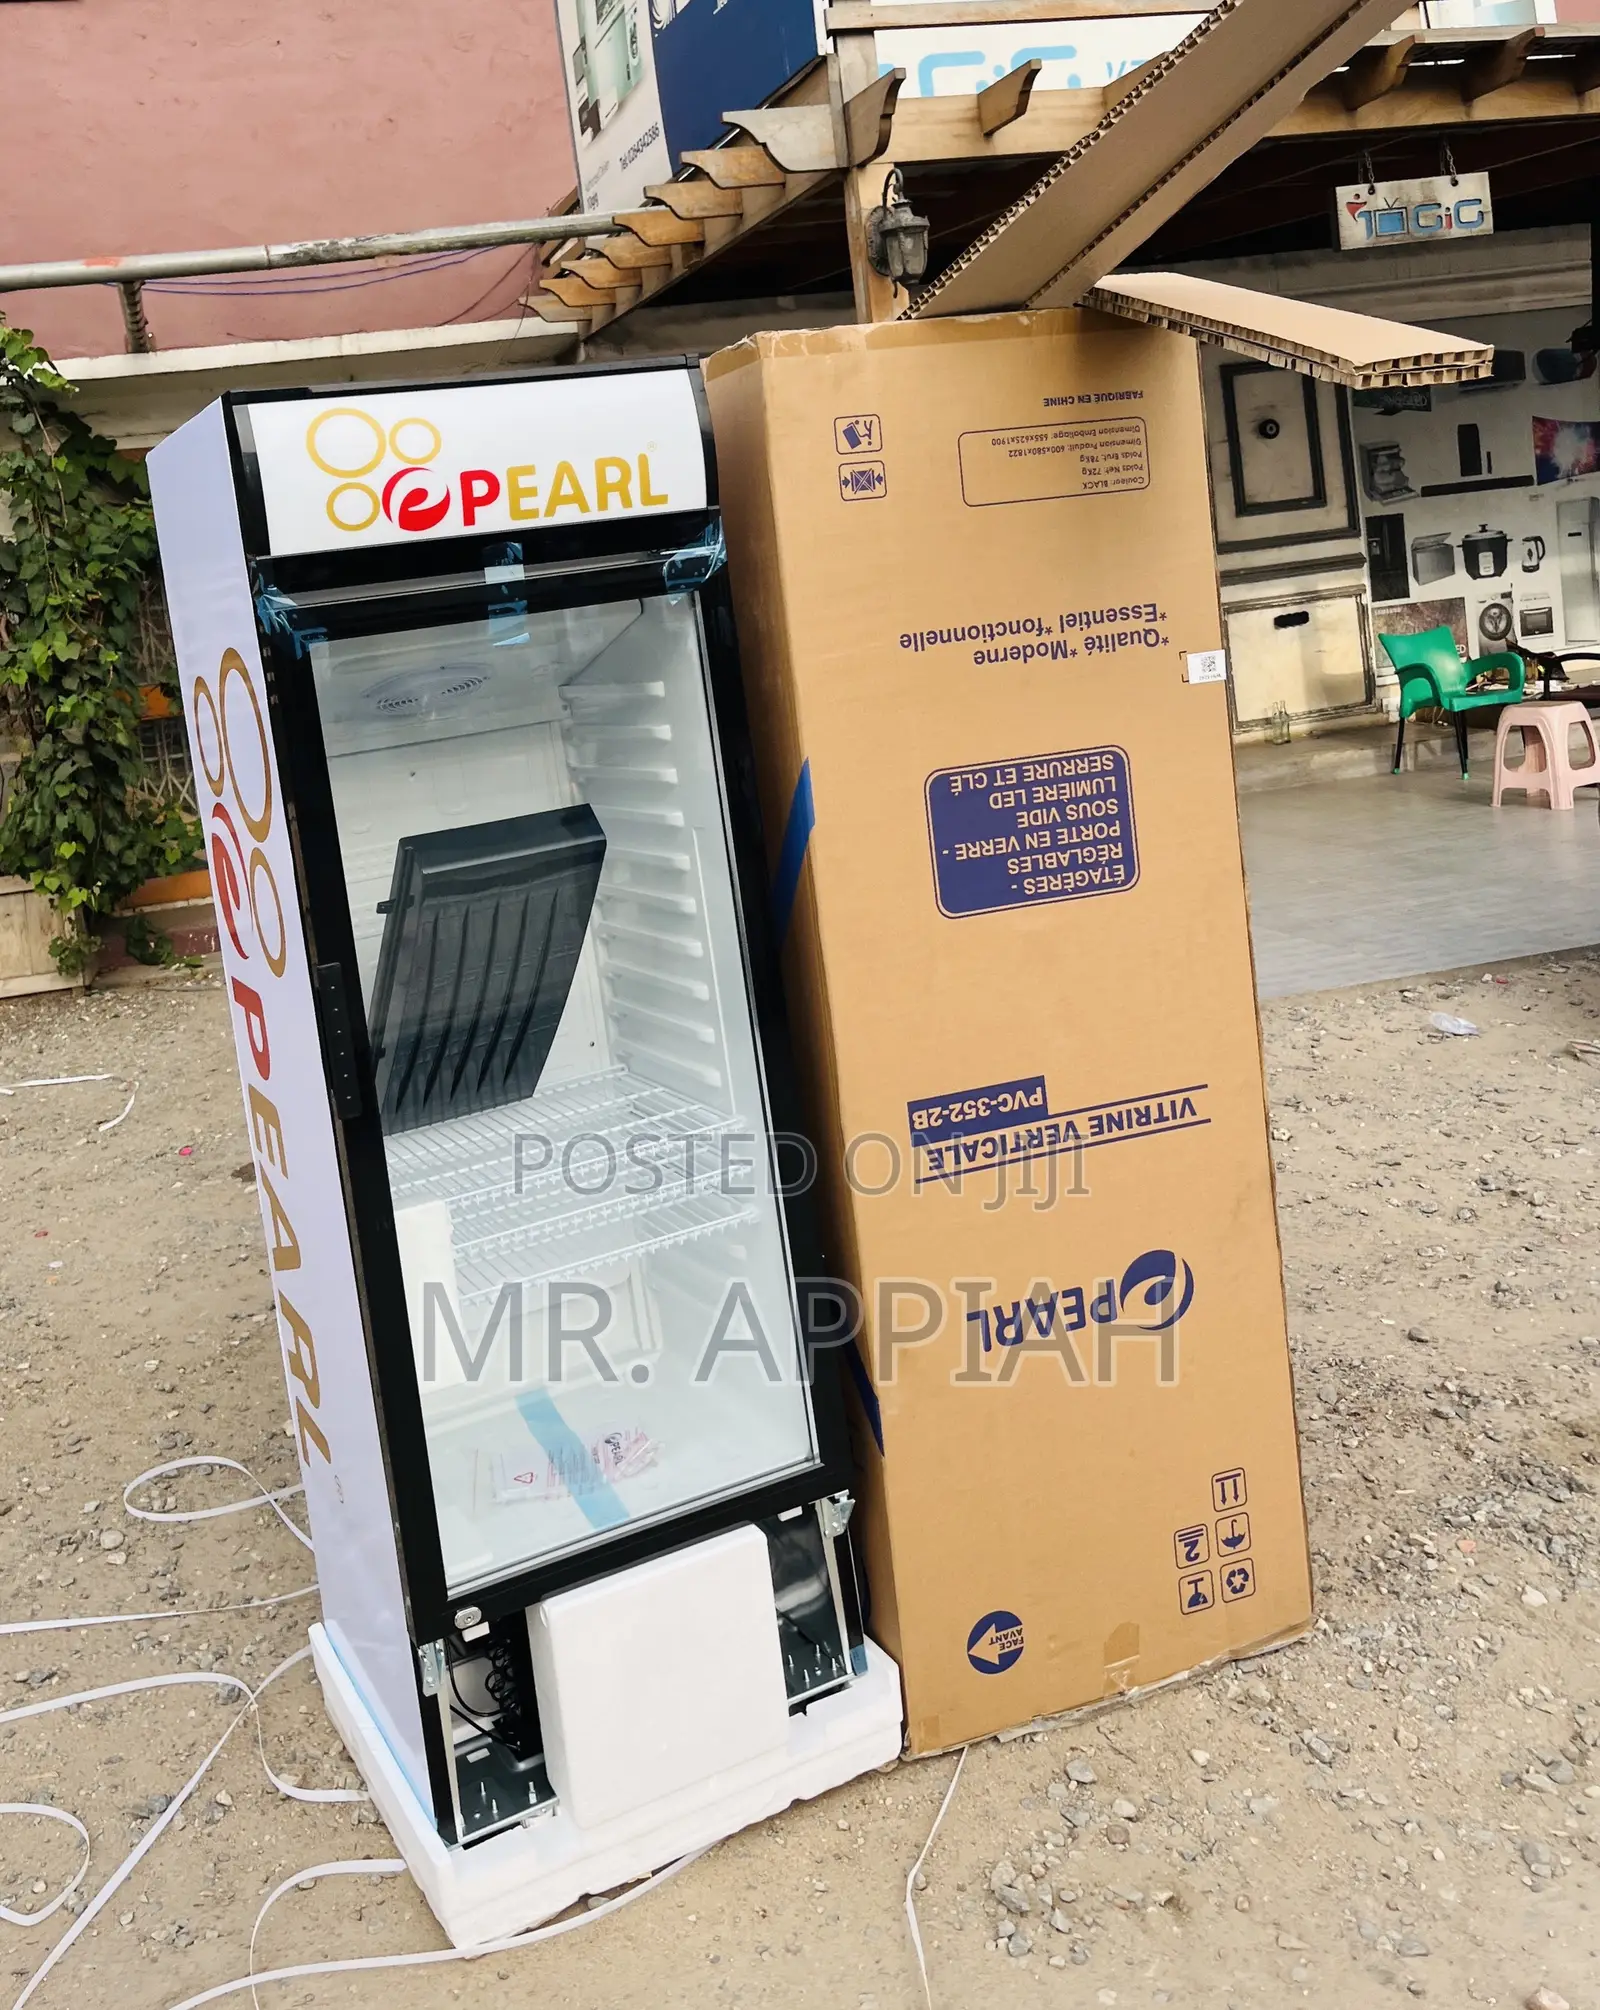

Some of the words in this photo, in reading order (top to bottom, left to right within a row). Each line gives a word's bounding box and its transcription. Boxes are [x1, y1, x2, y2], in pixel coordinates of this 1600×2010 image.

[1043, 396, 1075, 407] CHINE
[1077, 394, 1091, 404] EN
[991, 433, 1048, 446] 655x625x1900
[1099, 425, 1140, 437] Dimension
[1008, 444, 1065, 457] 600x580x1822
[1099, 438, 1141, 450] Dimension
[1121, 451, 1142, 461] Poids
[1081, 467, 1102, 476] 72Kg
[1122, 464, 1143, 474] Poids
[459, 454, 669, 526] PEARL
[1082, 480, 1108, 490] BLACK
[992, 766, 1017, 784] ET
[1022, 753, 1115, 781] SERRURE
[949, 771, 988, 796] CLÉ
[1033, 776, 1117, 804] LUMIÈRE
[989, 788, 1027, 808] LED
[1016, 806, 1061, 827] VIDE
[1066, 798, 1119, 819] SOUS
[1025, 830, 1051, 847] EN
[1056, 820, 1121, 844] PORTE
[955, 833, 1020, 859] VERRE
[1007, 842, 1123, 874] RÉGLABLES
[1023, 865, 1125, 893] ÉTAGÈRES
[912, 1087, 1044, 1131] PVC-352-2B
[1088, 1096, 1197, 1136] VITRINE
[926, 1115, 1083, 1173] VERTICALE
[966, 1279, 1117, 1352] PEARL
[988, 1627, 1024, 1645] AVANT
[998, 1635, 1024, 1651] FACE
